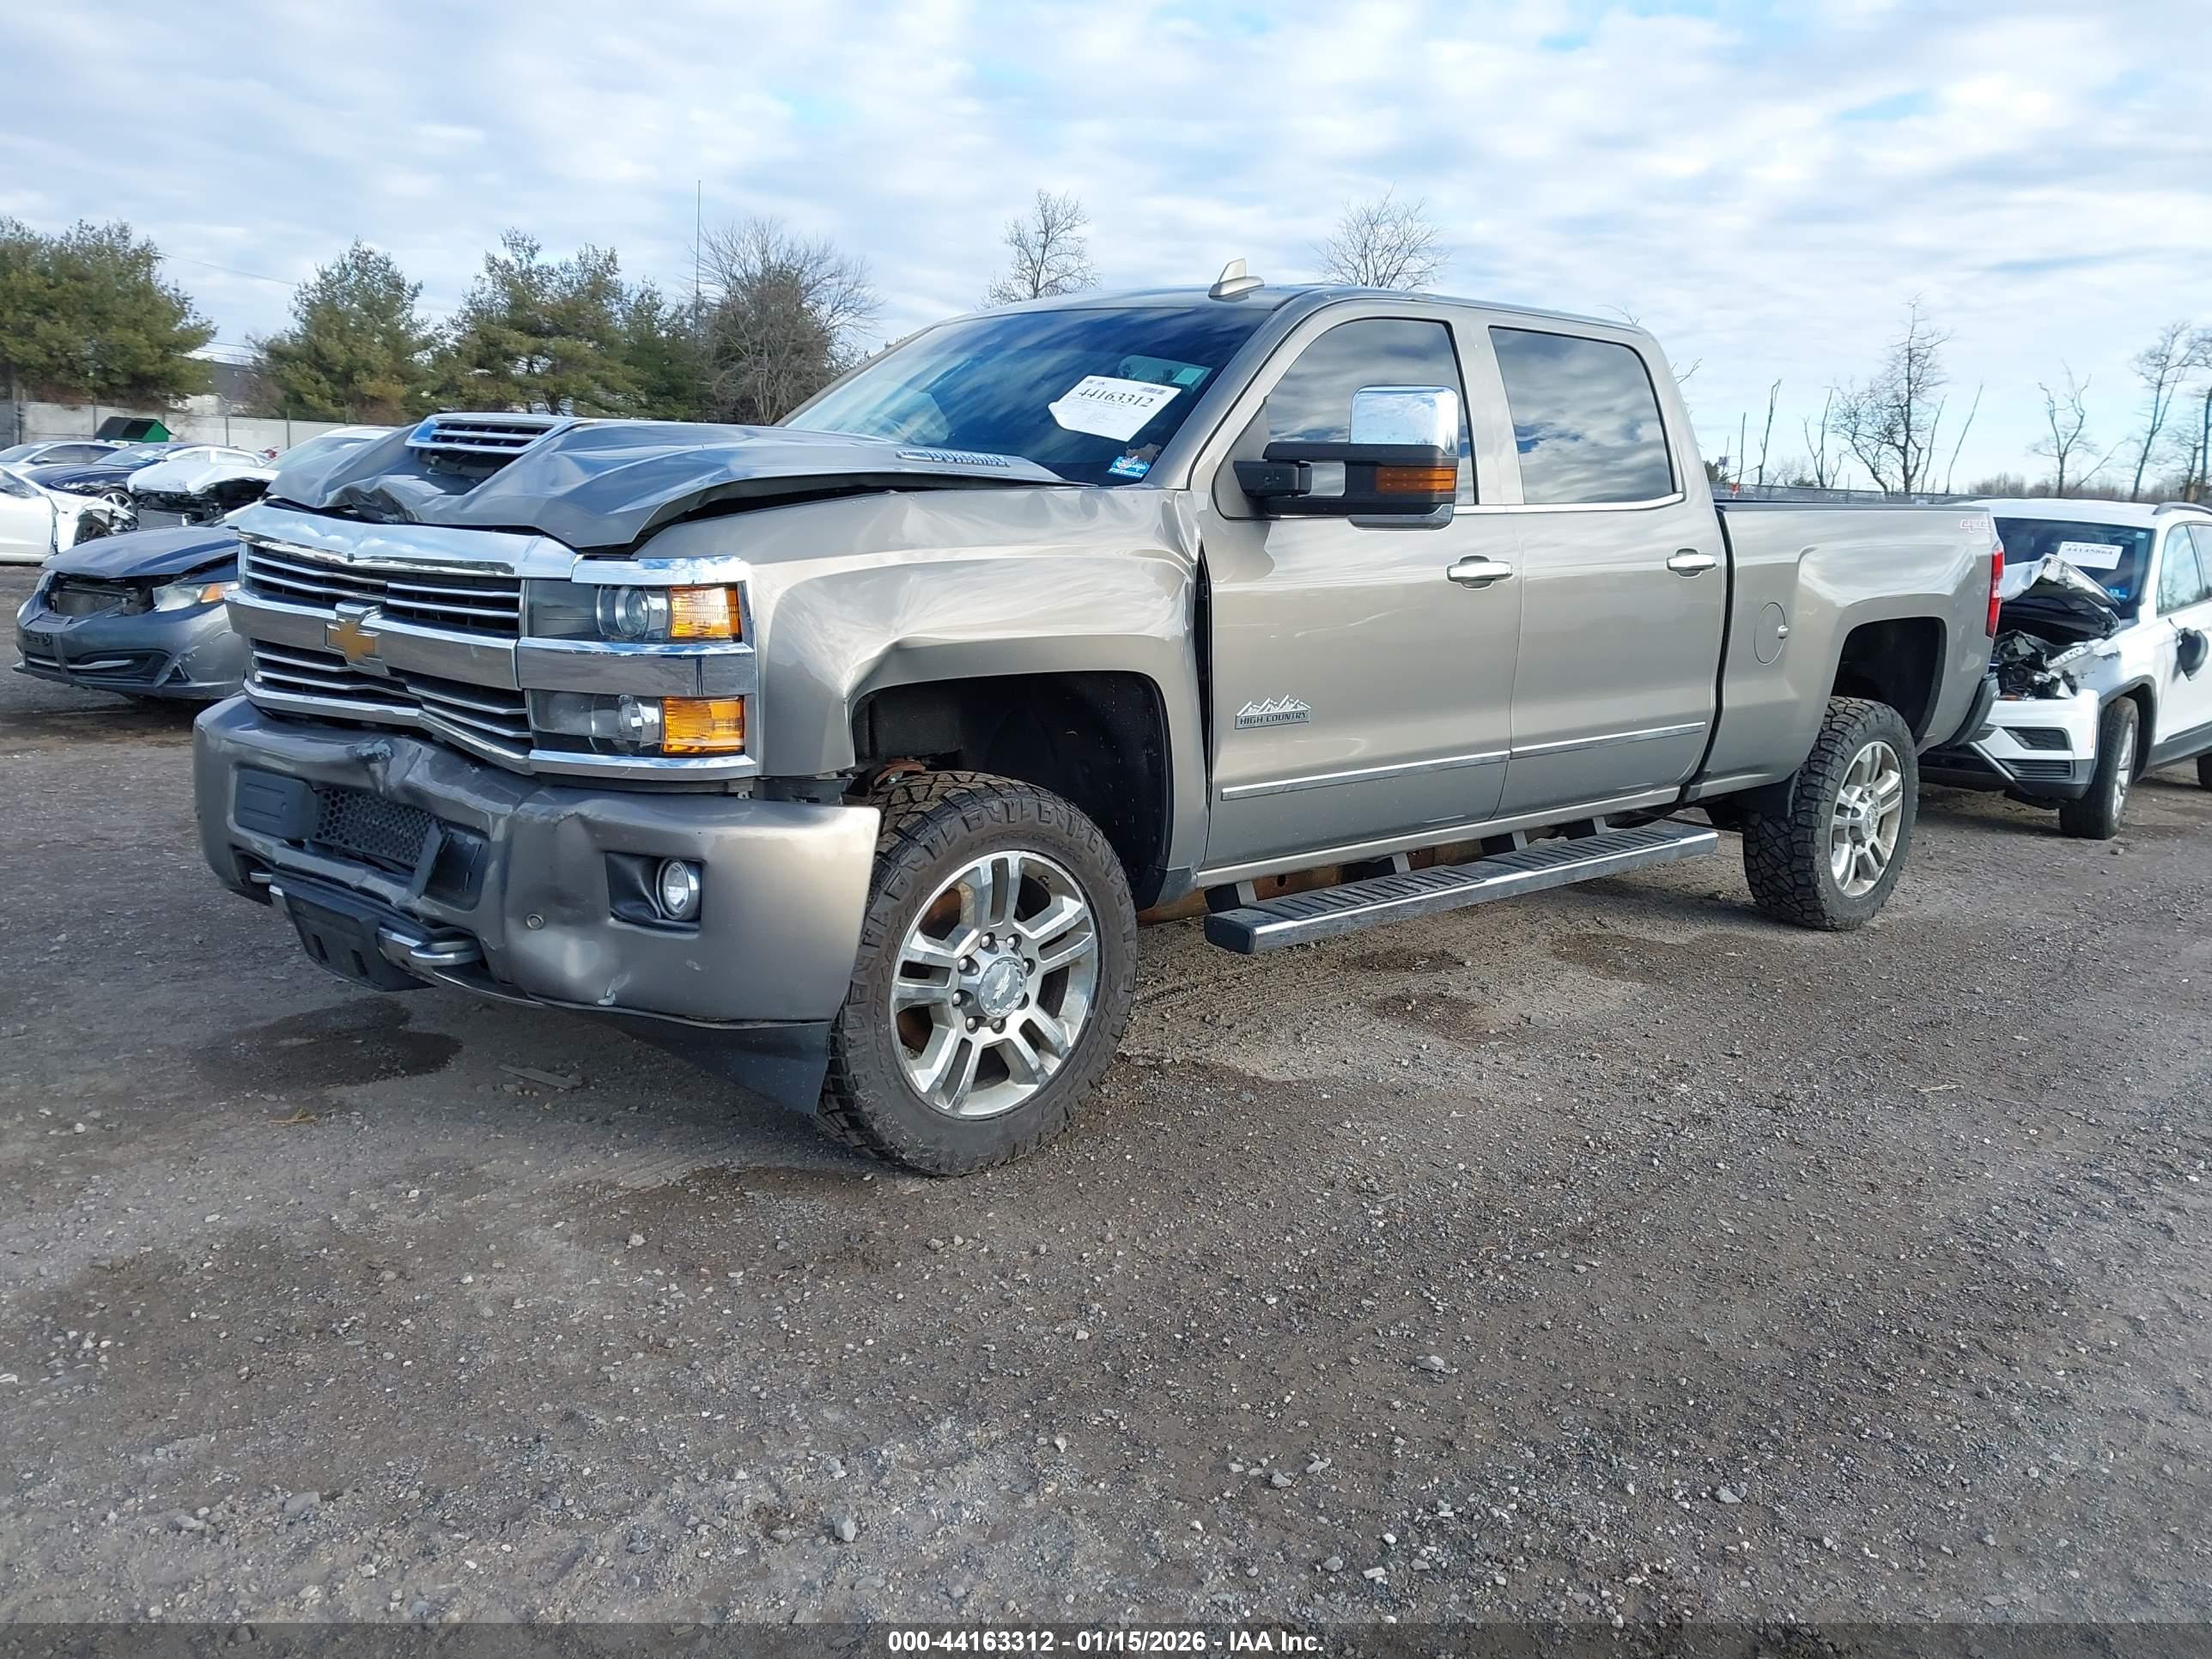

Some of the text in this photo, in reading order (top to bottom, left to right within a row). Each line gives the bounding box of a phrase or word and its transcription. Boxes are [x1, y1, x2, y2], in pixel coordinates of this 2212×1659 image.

[1079, 388, 1155, 408] 44163312
[1240, 712, 1307, 725] HIGH COUNTRY
